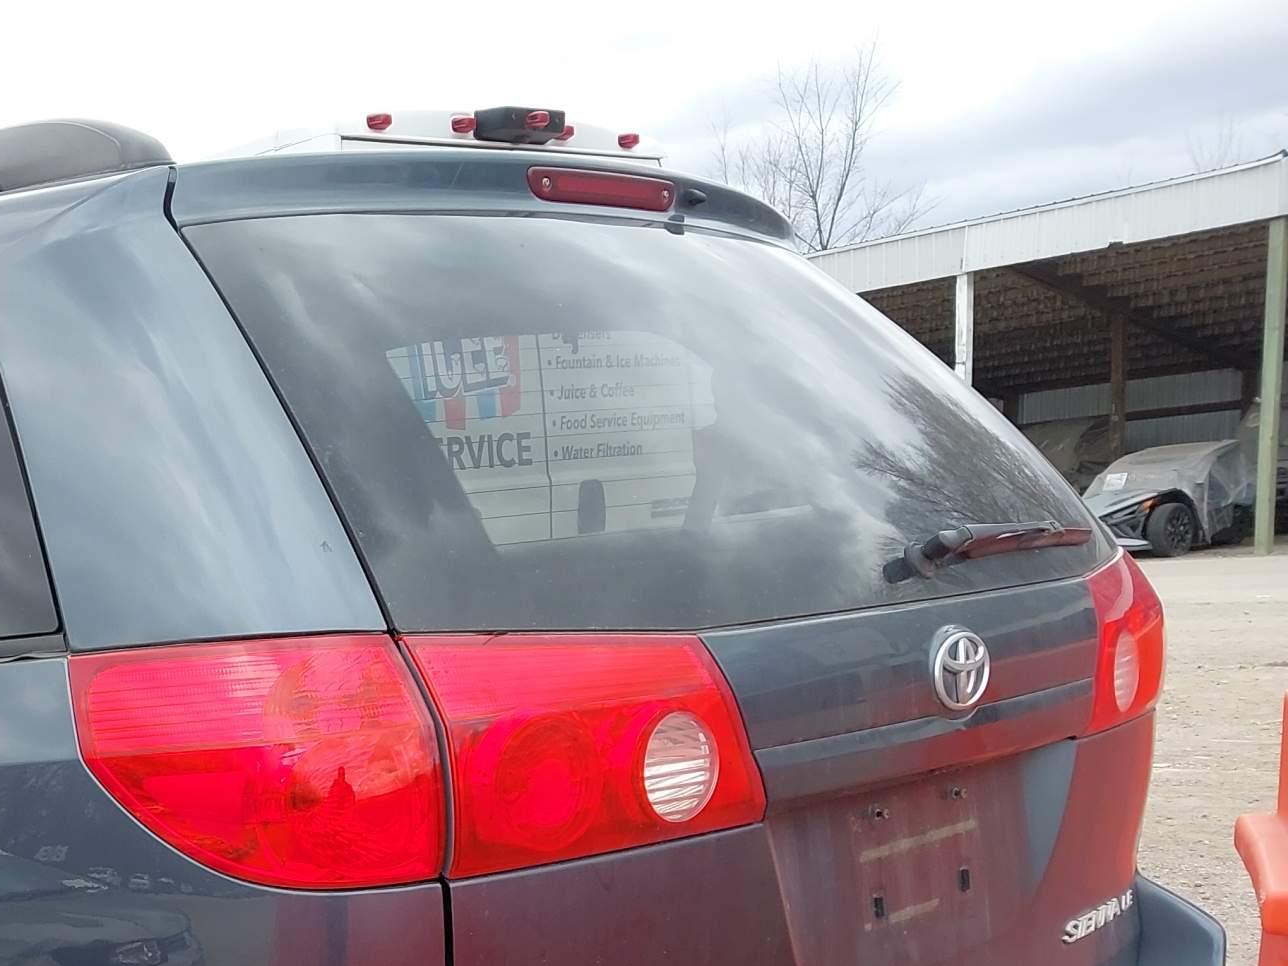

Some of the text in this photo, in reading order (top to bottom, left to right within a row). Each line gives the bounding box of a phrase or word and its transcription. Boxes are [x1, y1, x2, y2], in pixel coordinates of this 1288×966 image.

[555, 355, 603, 369] Fountain
[605, 354, 616, 368] &
[617, 354, 631, 368] Ice
[557, 382, 634, 401] Juice & Coffee
[560, 412, 685, 431] Food Service Equipment
[434, 432, 533, 471] RVICE
[562, 441, 643, 460] Water Filtration
